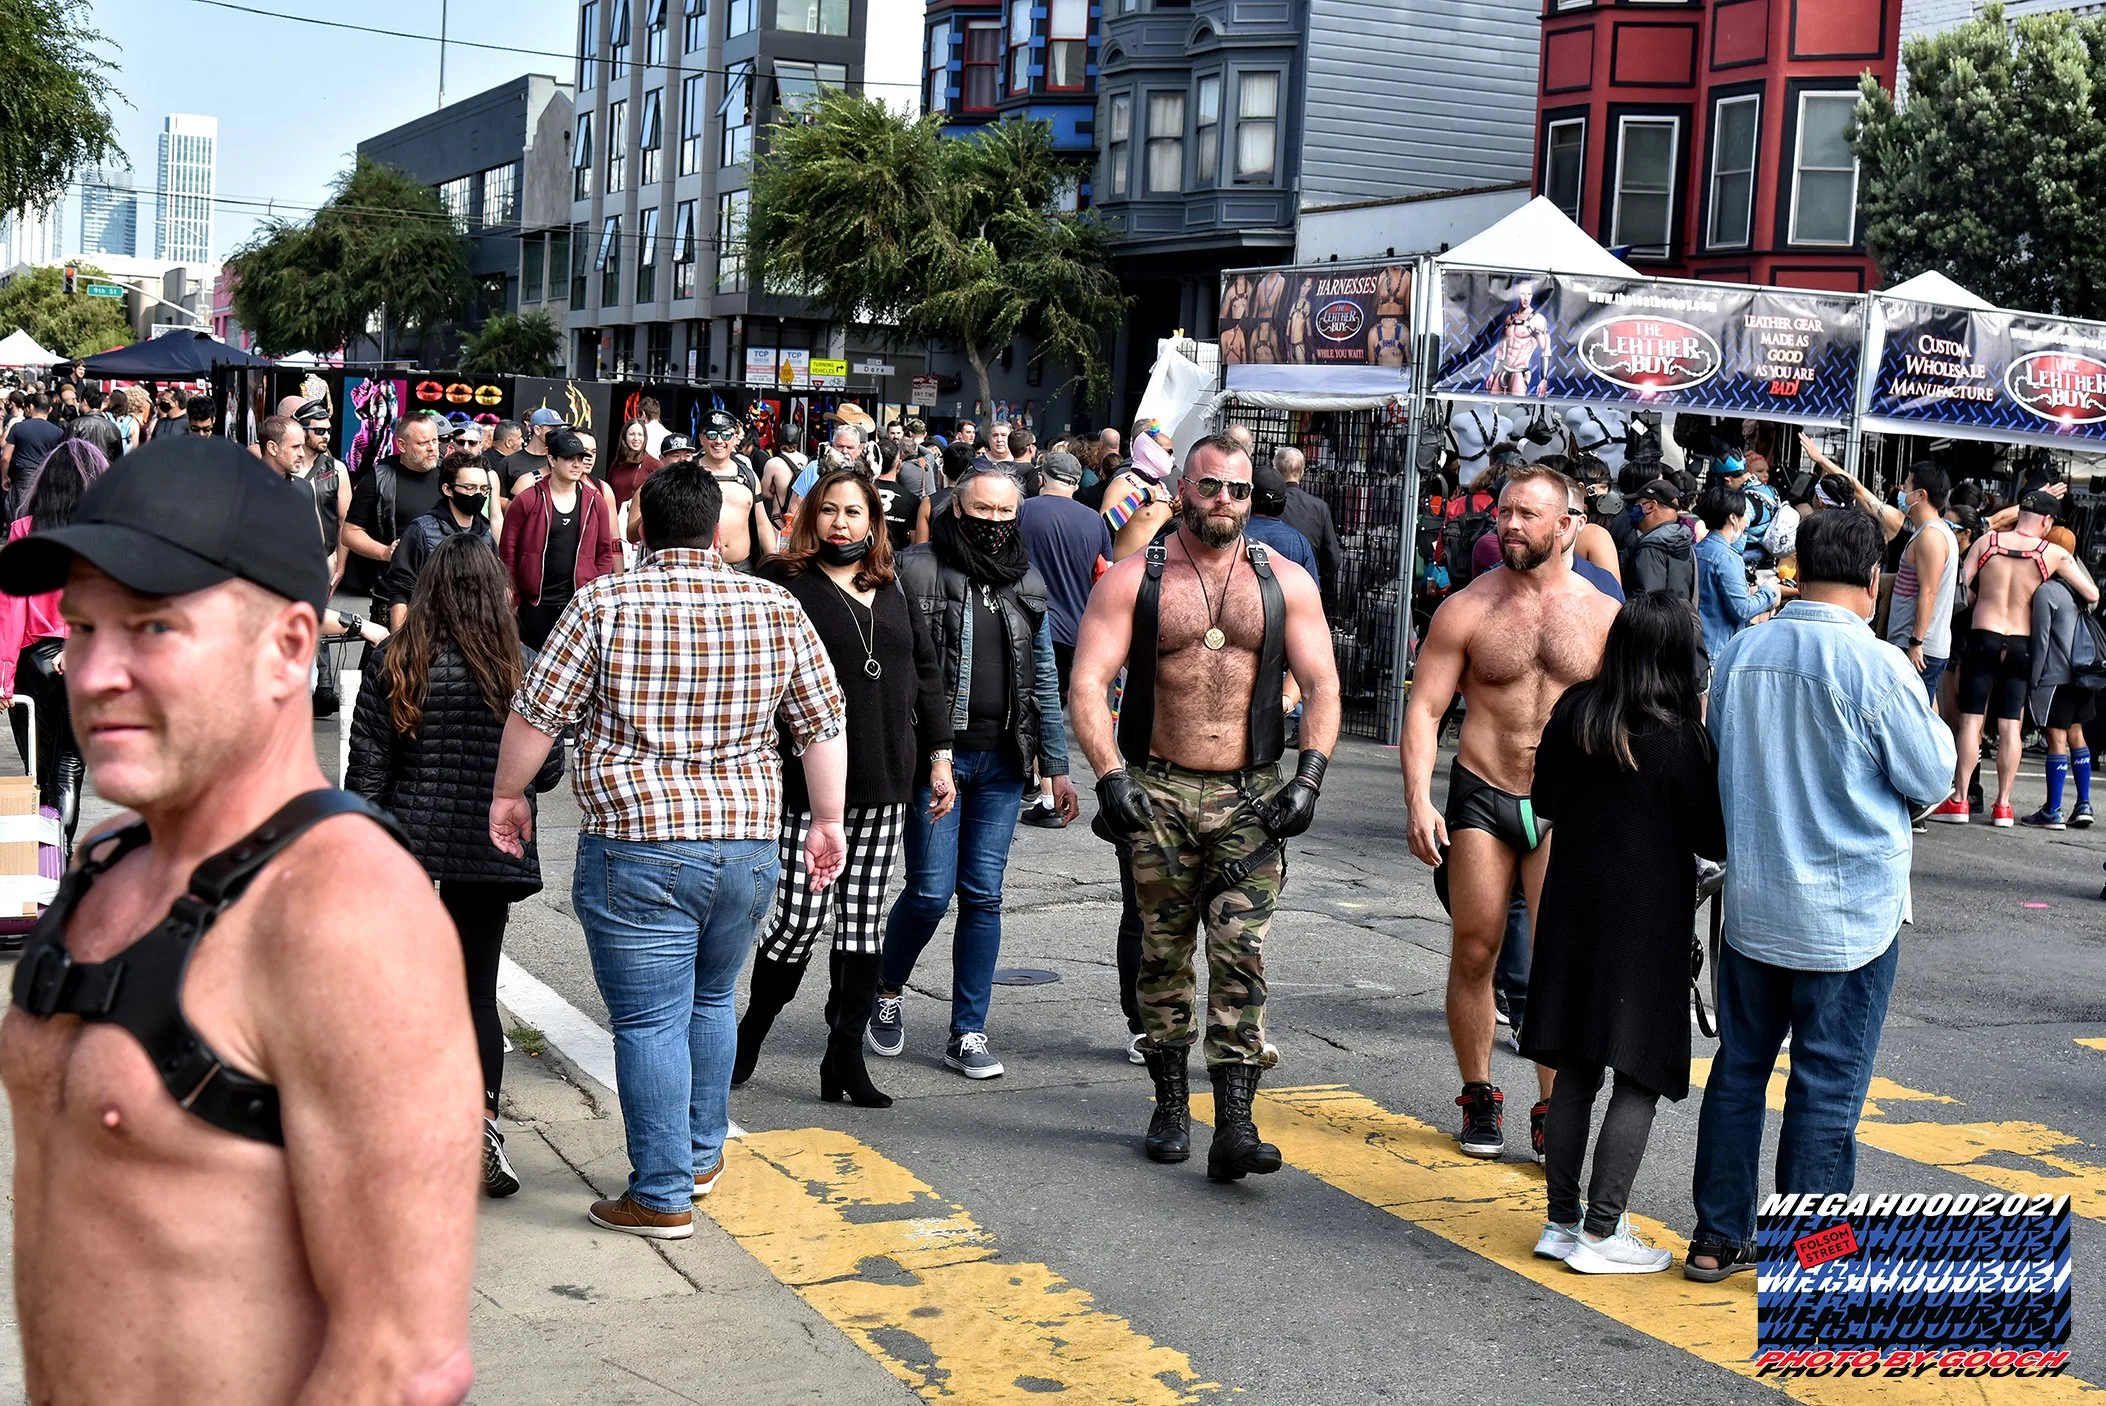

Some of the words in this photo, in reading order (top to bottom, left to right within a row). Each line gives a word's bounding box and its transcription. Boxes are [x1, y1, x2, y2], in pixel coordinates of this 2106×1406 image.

[1316, 277, 1377, 296] HARNESSES
[1588, 292, 1717, 313] www.theleatherboy.com
[1635, 322, 1664, 337] THE
[1744, 315, 1793, 330] LEATHER
[1793, 318, 1824, 332] GEAR
[1602, 326, 1701, 360] LEATHER
[1760, 332, 1794, 346] MADE
[1795, 335, 1809, 347] AS
[1918, 334, 1972, 358] CUSTOM
[754, 350, 769, 358] TCP
[1316, 349, 1334, 359] WHILE
[1335, 349, 1347, 359] YOU
[1347, 349, 1364, 359] WAIT!
[1767, 349, 1804, 363] GOOD
[1631, 354, 1677, 376] BOY
[1754, 364, 1768, 377] AS
[1769, 365, 1792, 379] YOU
[1792, 368, 1815, 381] ARE
[2055, 358, 2080, 373] THE
[1768, 380, 1800, 396] BAD!
[1889, 377, 1994, 401] MANUFACTURE
[2051, 388, 2091, 409] BOY
